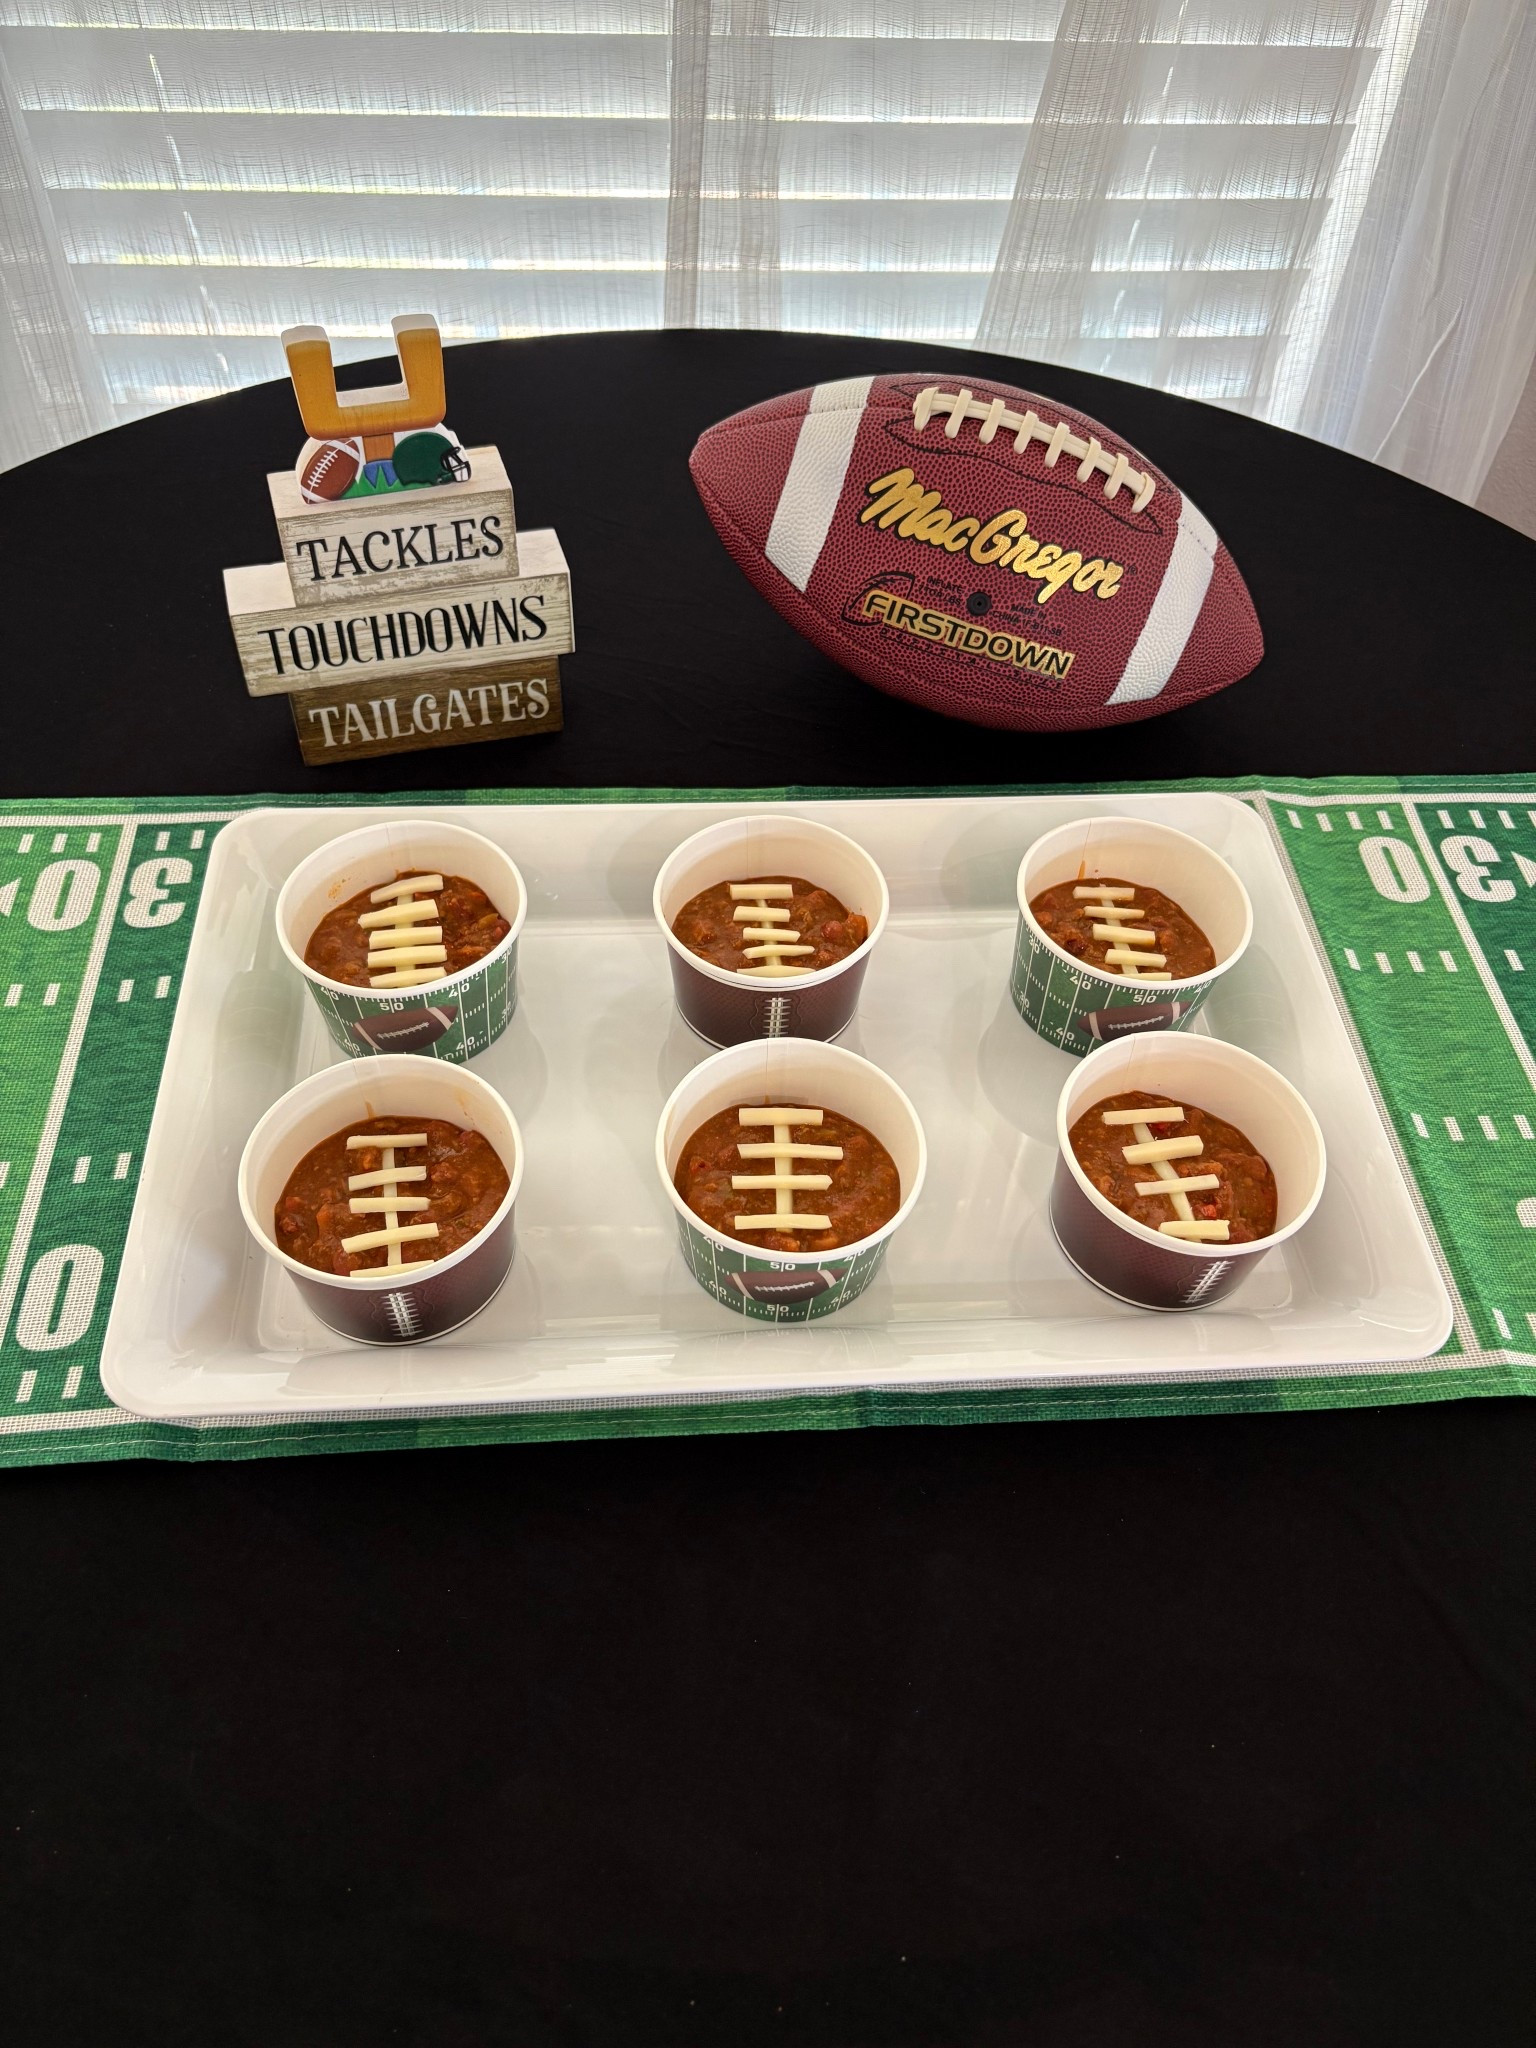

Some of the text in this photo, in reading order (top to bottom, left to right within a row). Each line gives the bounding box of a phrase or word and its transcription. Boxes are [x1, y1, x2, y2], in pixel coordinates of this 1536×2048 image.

[859, 467, 1125, 605] MacGregor
[296, 515, 504, 582] TACKLES
[928, 575, 963, 595] INFLATE
[992, 610, 1020, 624] CHINA
[1011, 603, 1047, 620] MADE IN
[258, 595, 547, 675] TOUCHDOWNS
[863, 591, 1073, 678] FIRSTDOWN
[308, 677, 550, 748] TAILGATES
[449, 982, 470, 998] 40
[1069, 975, 1091, 991] 40
[380, 1002, 405, 1011] 50
[1133, 995, 1157, 1004] 50
[1056, 1026, 1075, 1041] 40
[456, 1036, 475, 1051] 40
[769, 1261, 795, 1271] 50
[708, 1280, 727, 1295] 40
[830, 1290, 851, 1304] 40
[766, 1304, 789, 1312] 50
